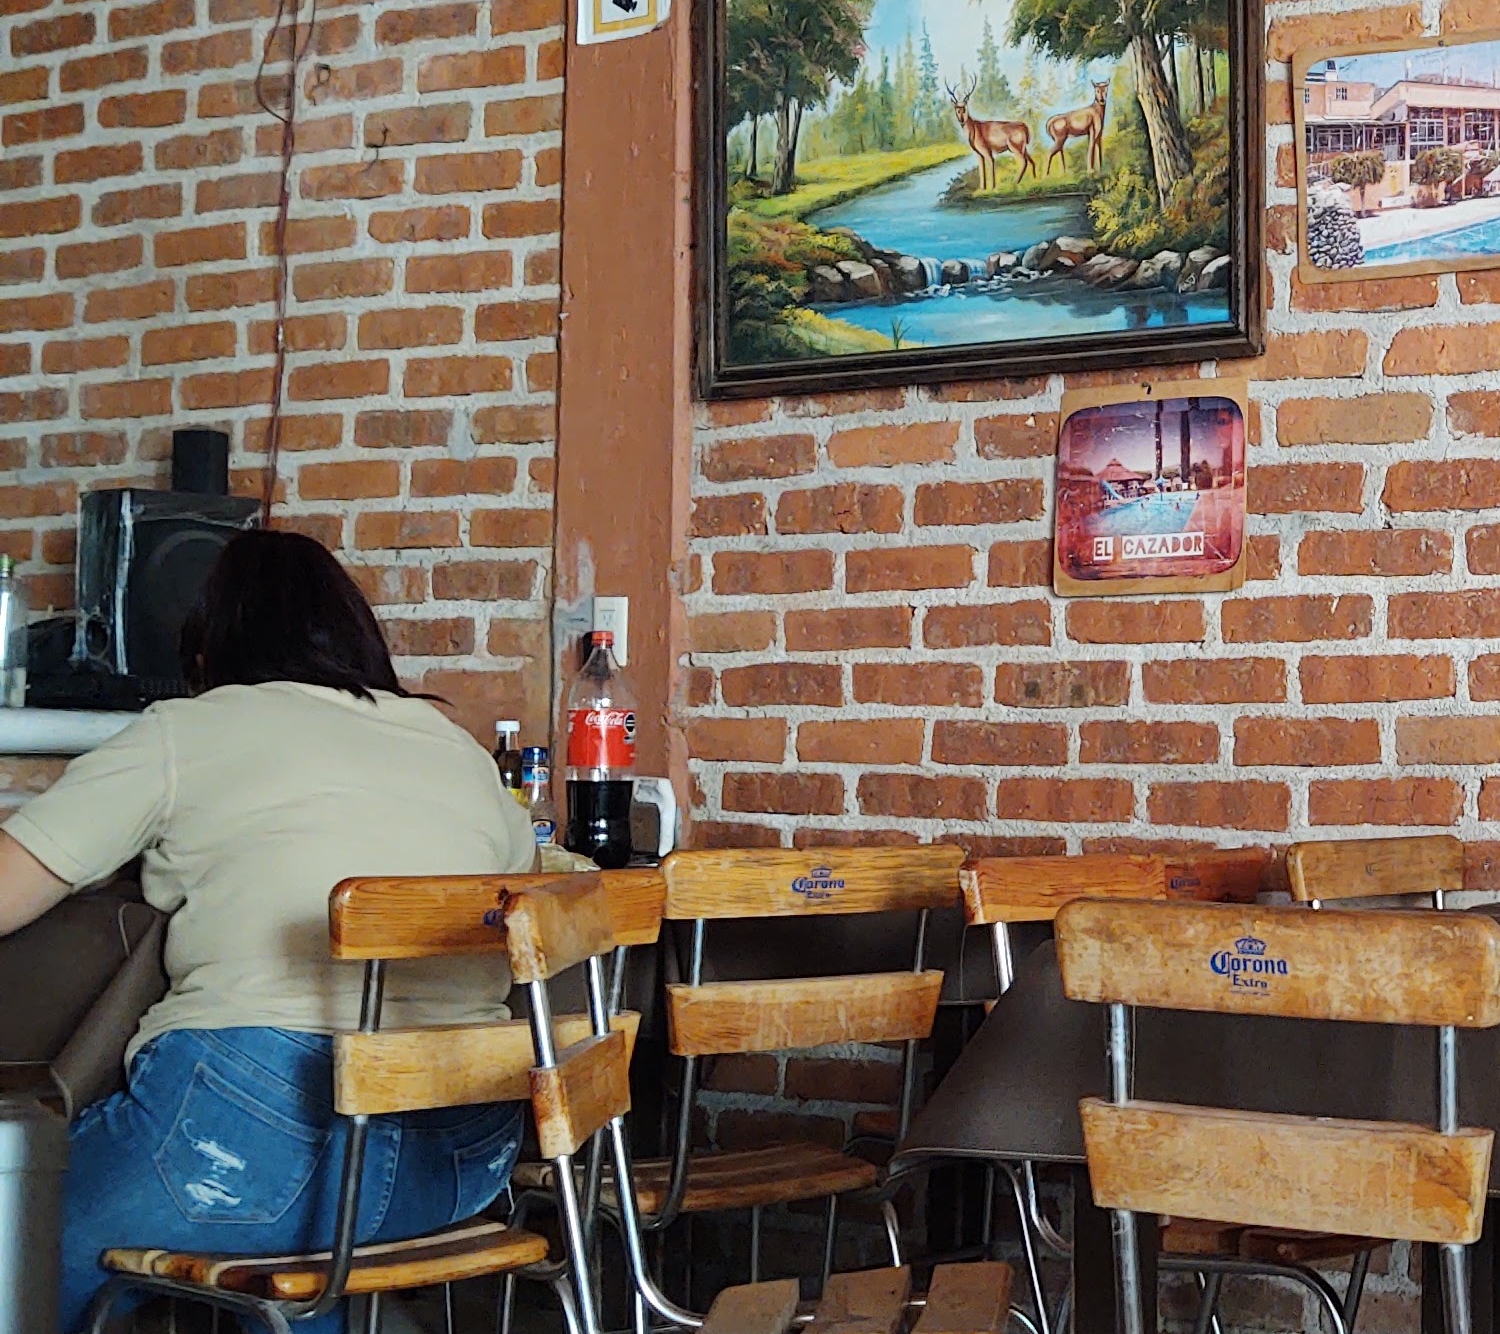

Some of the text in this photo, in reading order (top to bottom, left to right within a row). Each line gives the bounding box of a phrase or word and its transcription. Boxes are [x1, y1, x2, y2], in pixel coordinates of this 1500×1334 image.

[1094, 534, 1203, 558] EL CAZADOR
[1210, 950, 1288, 979] Corona
[1233, 973, 1268, 988] Extra
